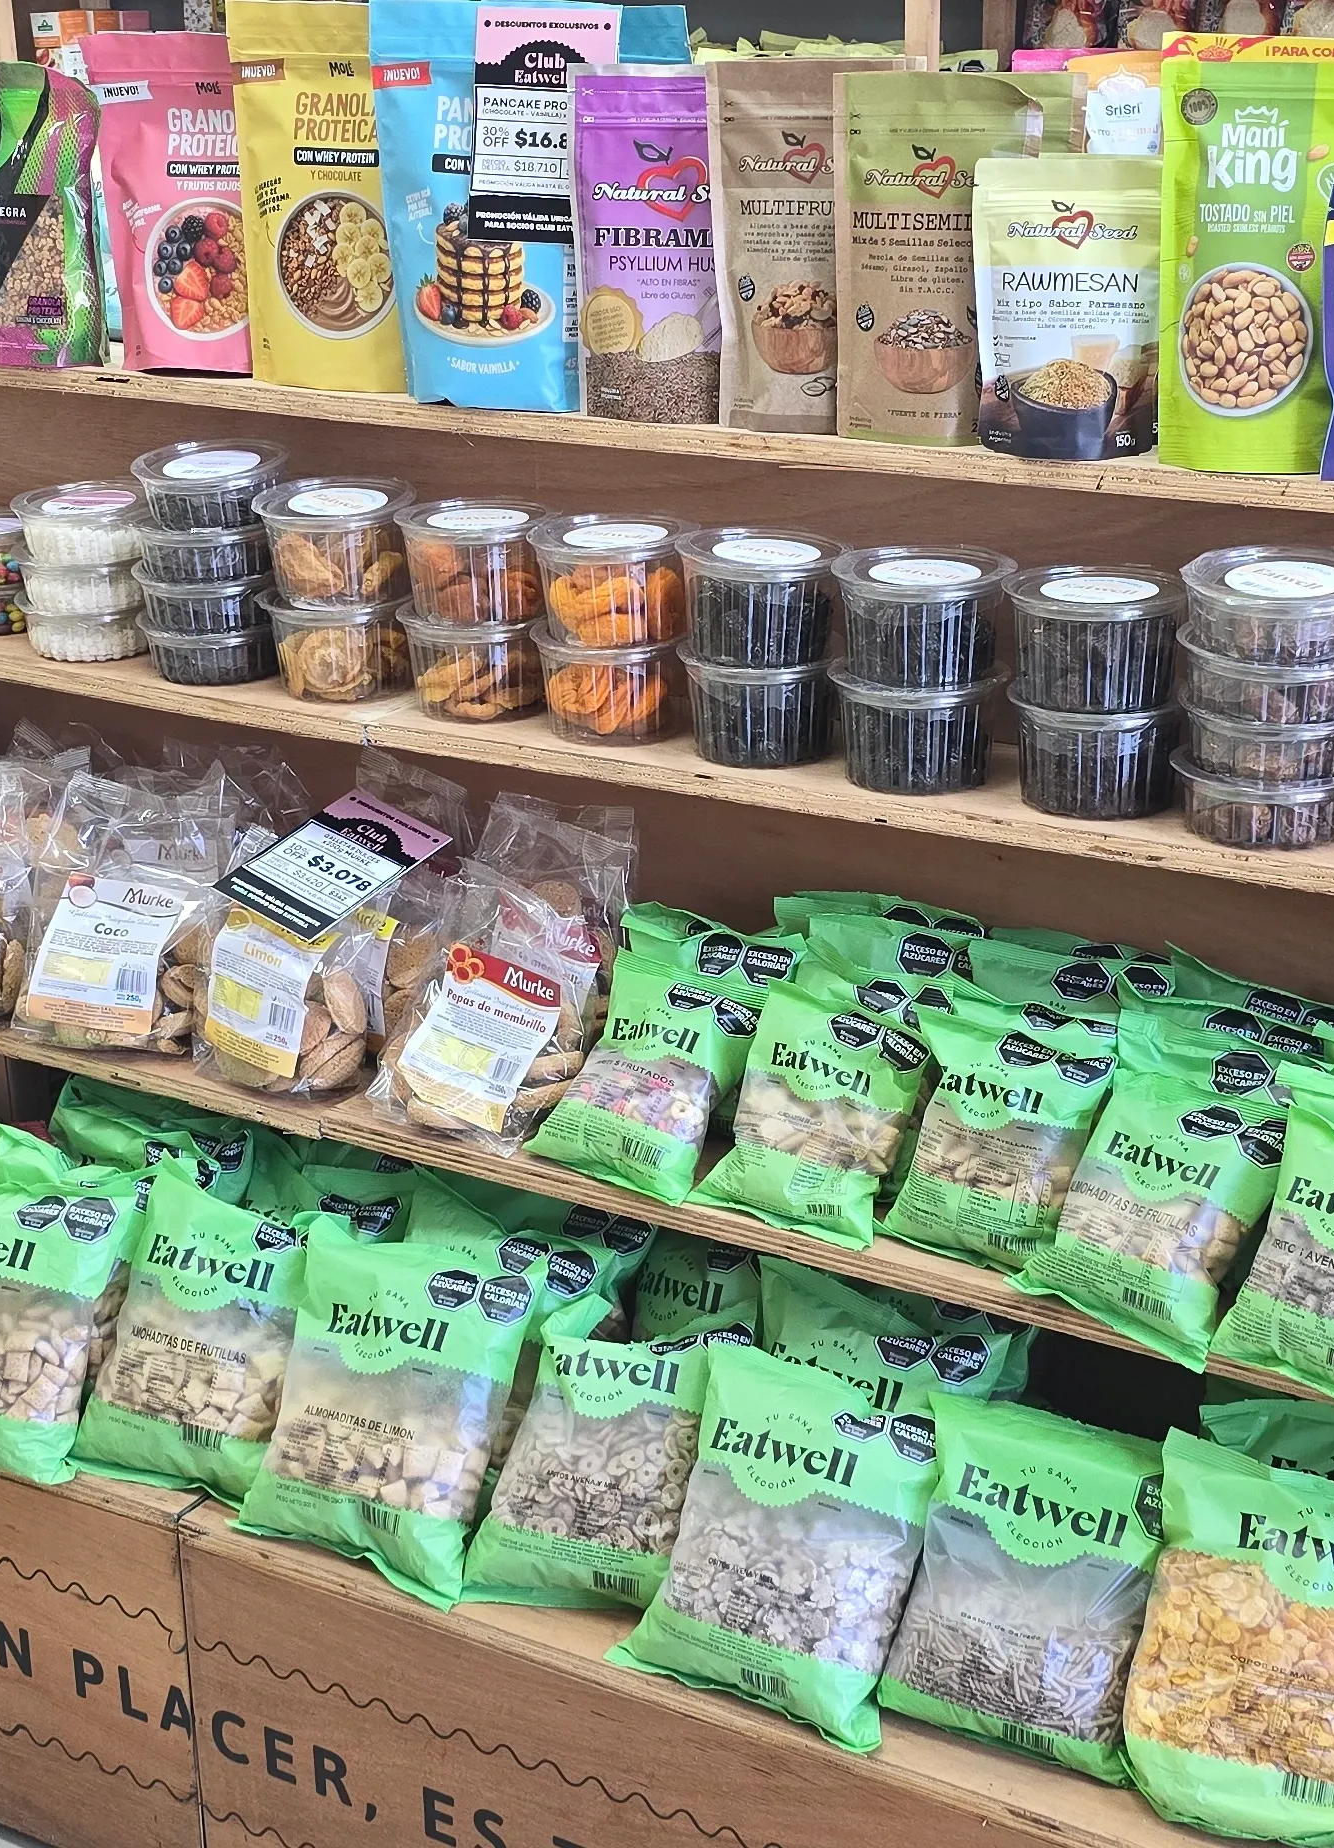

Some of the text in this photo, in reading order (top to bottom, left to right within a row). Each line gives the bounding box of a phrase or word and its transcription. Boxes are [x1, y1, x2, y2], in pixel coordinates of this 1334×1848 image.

[495, 20, 599, 30] DESCUENTOS EXCLUSIVOS
[329, 61, 355, 78] MOLÉ
[524, 52, 565, 69] Club
[383, 66, 421, 82] ¡NUEVO!
[103, 86, 139, 98] ¡NUEVO!
[195, 80, 222, 95] MOLÉ
[483, 96, 541, 110] PANCAKE
[482, 126, 509, 137] 30%
[1221, 120, 1290, 148] Maní
[483, 136, 509, 148] OFF
[297, 150, 375, 164] CON WHEY PROTEIN
[169, 164, 215, 175] CON WHEY
[319, 170, 362, 182] CHOCOLATE
[864, 168, 947, 188] Natural
[183, 180, 241, 192] FRUTOS ROJOS
[593, 182, 687, 202] Natural
[1199, 204, 1296, 224] TOSTADO SIN PIEL
[1007, 222, 1138, 241] Natural Seed
[609, 256, 683, 272] PSYLLIUM
[1001, 272, 1139, 294] RAWMESAN
[997, 298, 1146, 311] Mix tipo Sabor Parmesano
[450, 356, 516, 375] SABOR VAINILLA
[1115, 434, 1137, 448] 150g
[355, 824, 389, 845] Club
[307, 854, 373, 894] $3.078
[121, 887, 175, 910] Murke
[93, 922, 129, 940] Coco
[243, 942, 283, 969] Limón
[503, 966, 555, 1000] Murke
[611, 1016, 701, 1054] Eatwell
[621, 1060, 676, 1088] FRUTADOS
[771, 1041, 871, 1098] Eatwell
[1103, 1130, 1221, 1191] Eatwell
[1128, 1201, 1199, 1238] DE FRUTILLAS
[147, 1232, 275, 1294] Eatwell
[326, 1302, 450, 1353] Eatwell
[303, 1404, 416, 1442] ALMOHADITAS DE LIMON
[709, 1416, 859, 1488] Eatwell
[955, 1462, 1129, 1549] Eatwell
[73, 1648, 377, 1822] PLACER,
[422, 1786, 505, 1848] ES
